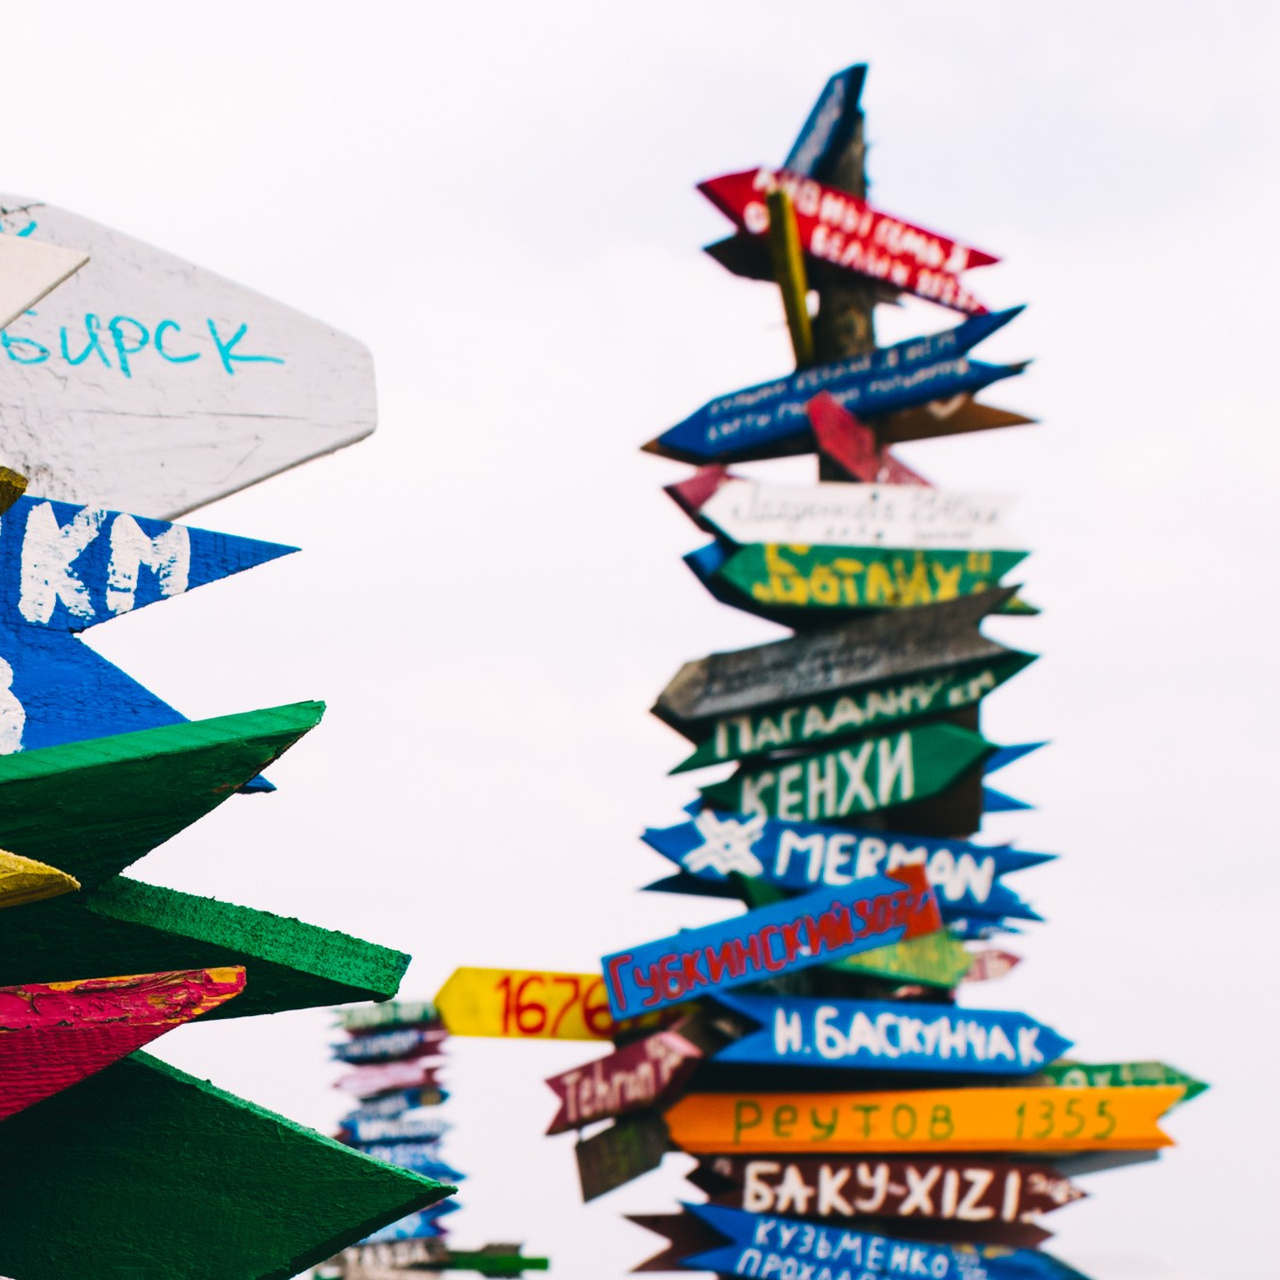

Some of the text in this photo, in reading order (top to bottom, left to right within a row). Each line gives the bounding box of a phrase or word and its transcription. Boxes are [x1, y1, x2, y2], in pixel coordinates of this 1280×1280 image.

[18, 501, 190, 624] КМ
[741, 731, 915, 822] КЕНХИ
[774, 1005, 1045, 1067] Н.БАСКУНЧАК
[1015, 1098, 1119, 1141] 1355
[754, 1218, 950, 1280] КУЗЬМЕНКО
